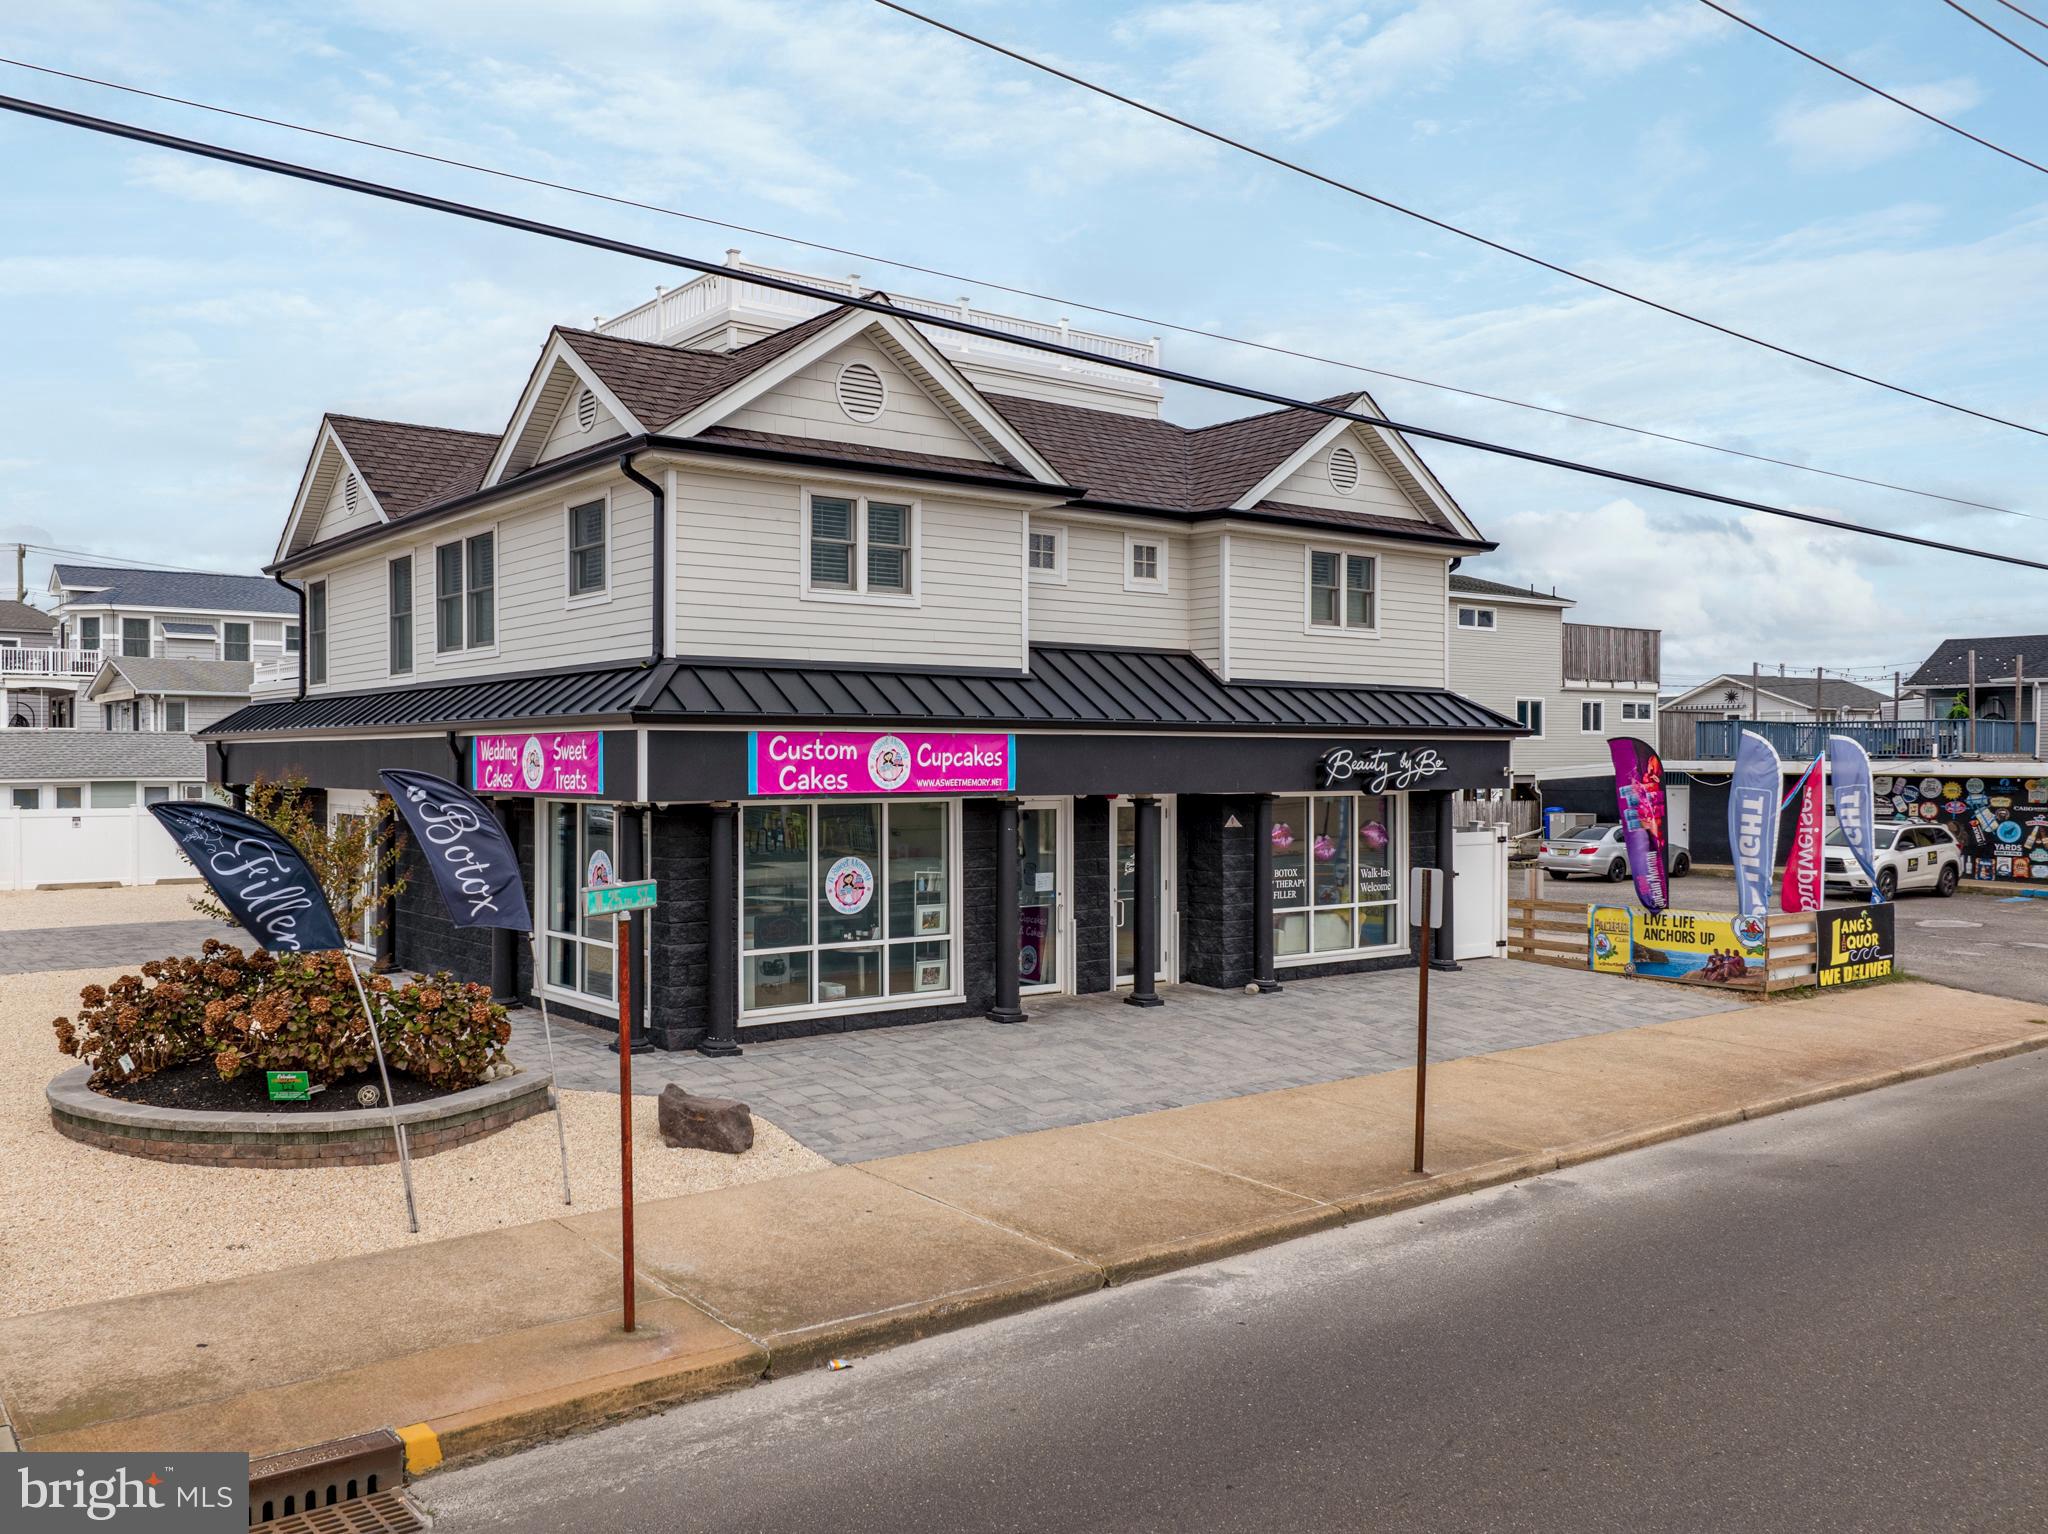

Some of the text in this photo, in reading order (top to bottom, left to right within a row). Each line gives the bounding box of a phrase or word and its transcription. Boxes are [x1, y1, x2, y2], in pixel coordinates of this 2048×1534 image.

[481, 740, 518, 766] Wedding
[553, 736, 588, 761] Sweet
[769, 735, 858, 761] Custom
[917, 743, 1003, 773] Cupcakes
[485, 765, 513, 788] Cakes
[553, 766, 588, 790] Treats
[779, 765, 849, 791] Cakes
[917, 778, 1003, 787] WWW.ASWEETMEMORY.NET
[1325, 749, 1402, 793] Beauty
[1994, 843, 2022, 852] YARDS
[418, 802, 498, 917] Botox
[1274, 868, 1298, 878] BOTOX
[1276, 879, 1306, 889] THERAPY
[1360, 868, 1391, 878] Walk-Ins
[210, 838, 312, 950] Filler
[1273, 890, 1297, 899] FILLER
[1360, 882, 1391, 892] Welcome
[1644, 913, 1695, 929] LIVE LIFE
[1643, 927, 1696, 944] ANCHORS
[1700, 932, 1715, 945] UP
[1820, 960, 1891, 987] WE DELIVER
